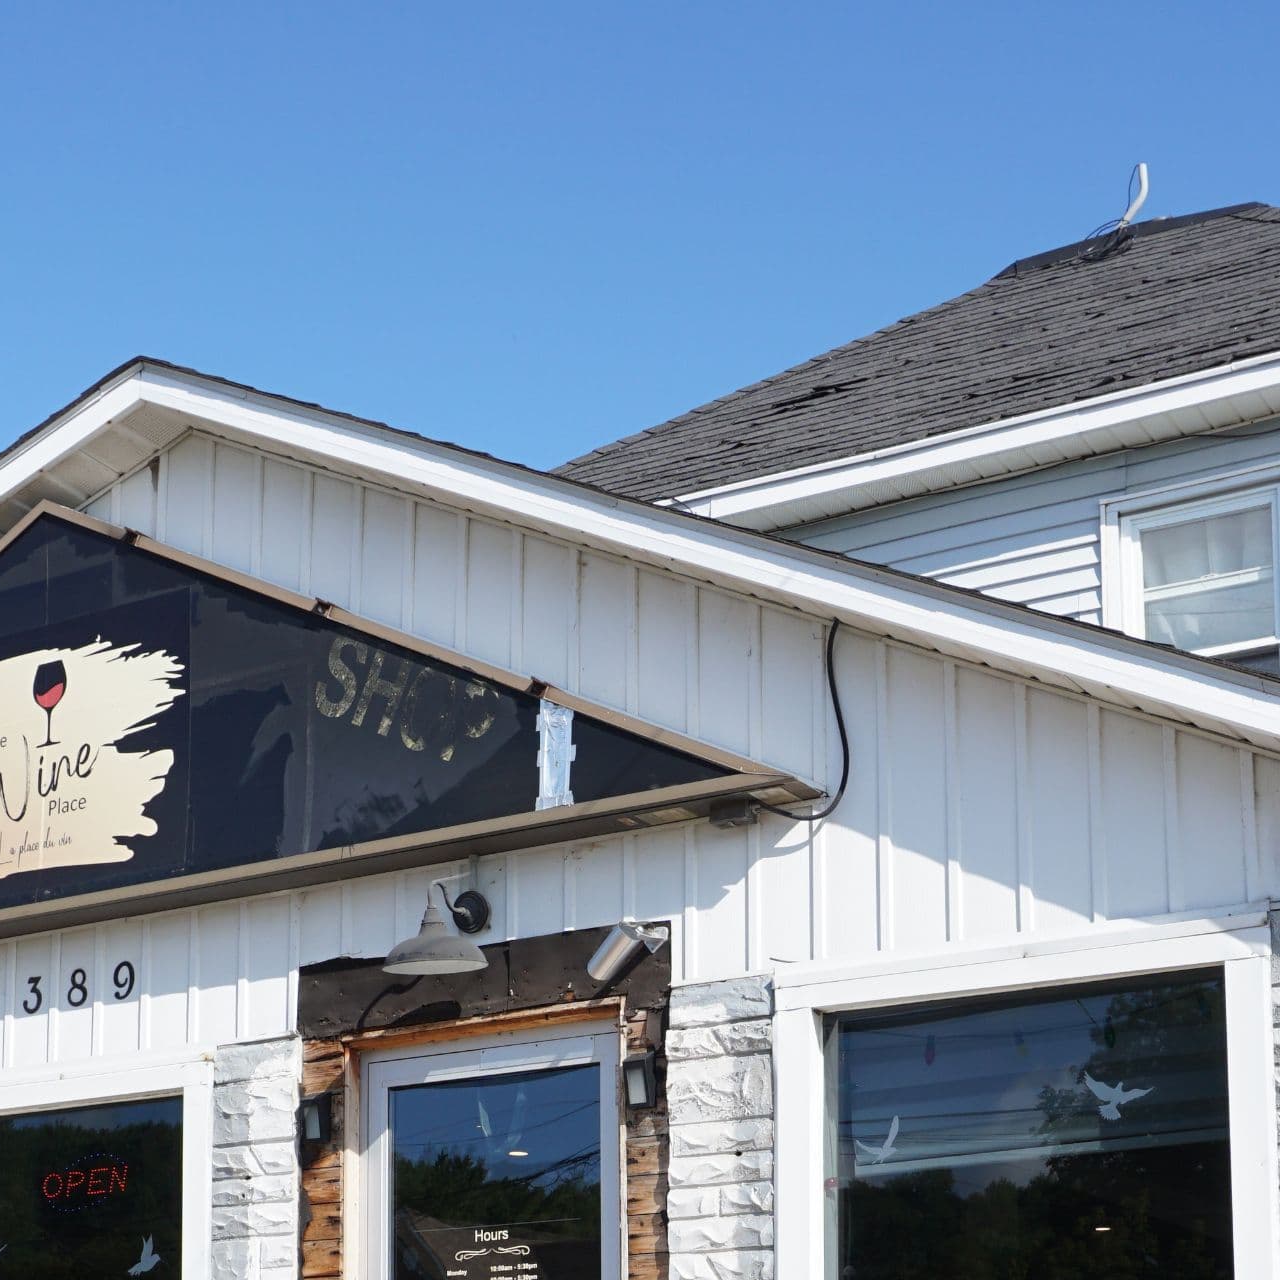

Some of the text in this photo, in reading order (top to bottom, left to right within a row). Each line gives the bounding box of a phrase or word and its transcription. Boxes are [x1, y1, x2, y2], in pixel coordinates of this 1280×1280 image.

[48, 797, 87, 816] Place
[18, 830, 39, 869] place
[43, 826, 55, 849] du
[22, 960, 136, 1015] 389
[42, 1164, 129, 1199] OPEN
[474, 1229, 509, 1243] Hours
